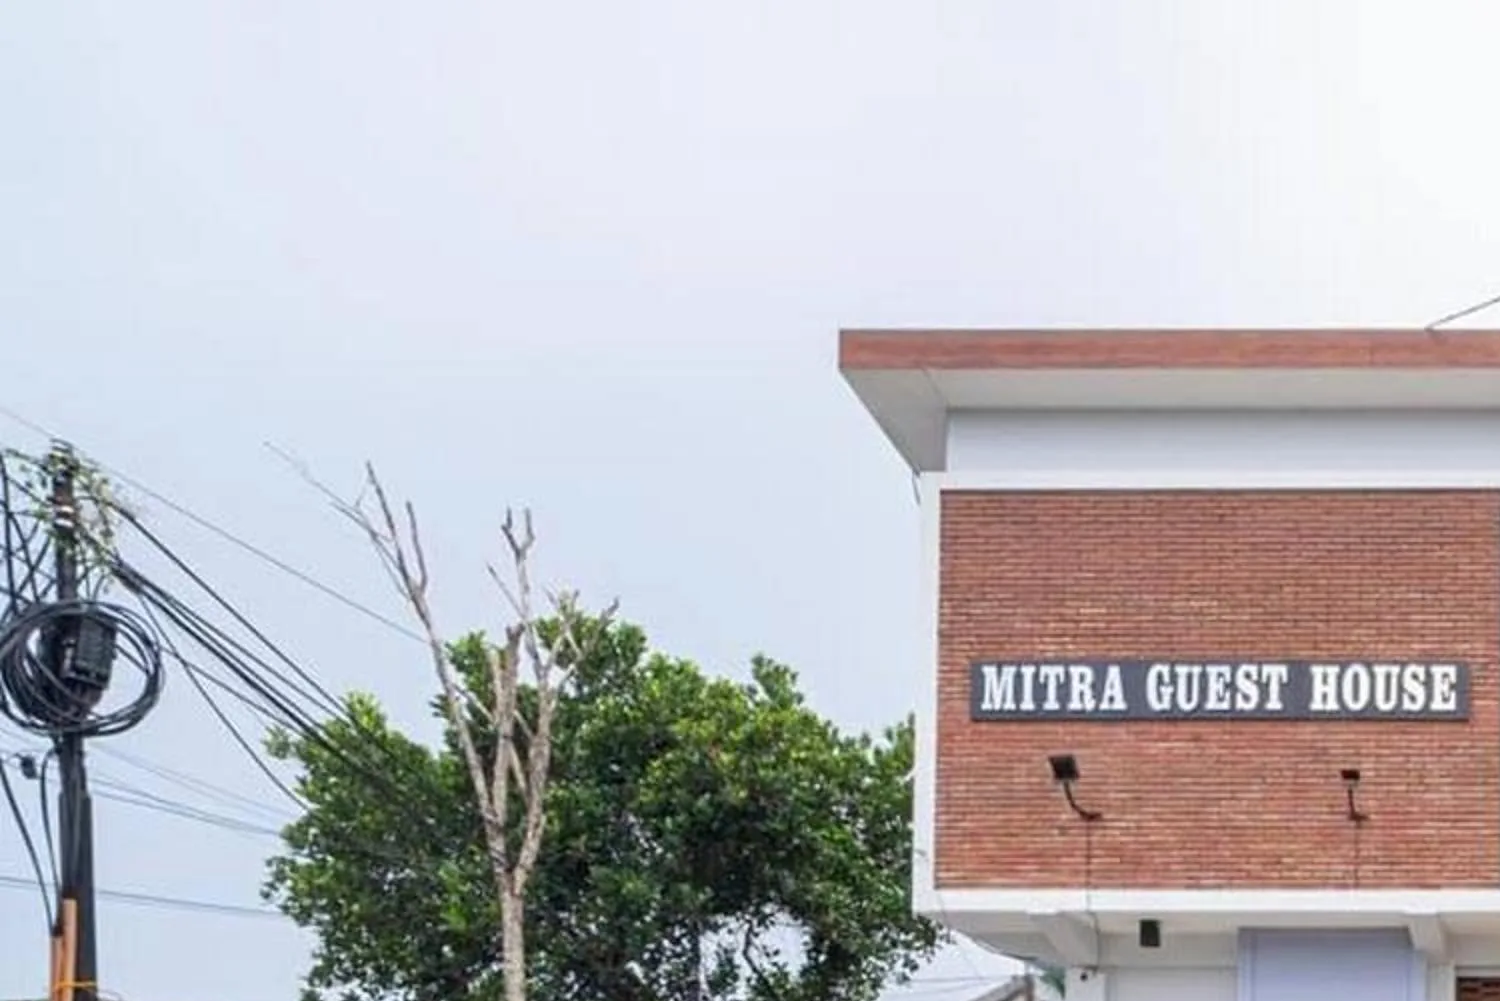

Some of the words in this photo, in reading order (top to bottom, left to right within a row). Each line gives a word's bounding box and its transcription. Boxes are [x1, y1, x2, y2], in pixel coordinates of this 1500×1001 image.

[980, 664, 1128, 712] MITRA
[1145, 662, 1289, 711] GUEST
[1309, 663, 1458, 711] HOUSE
